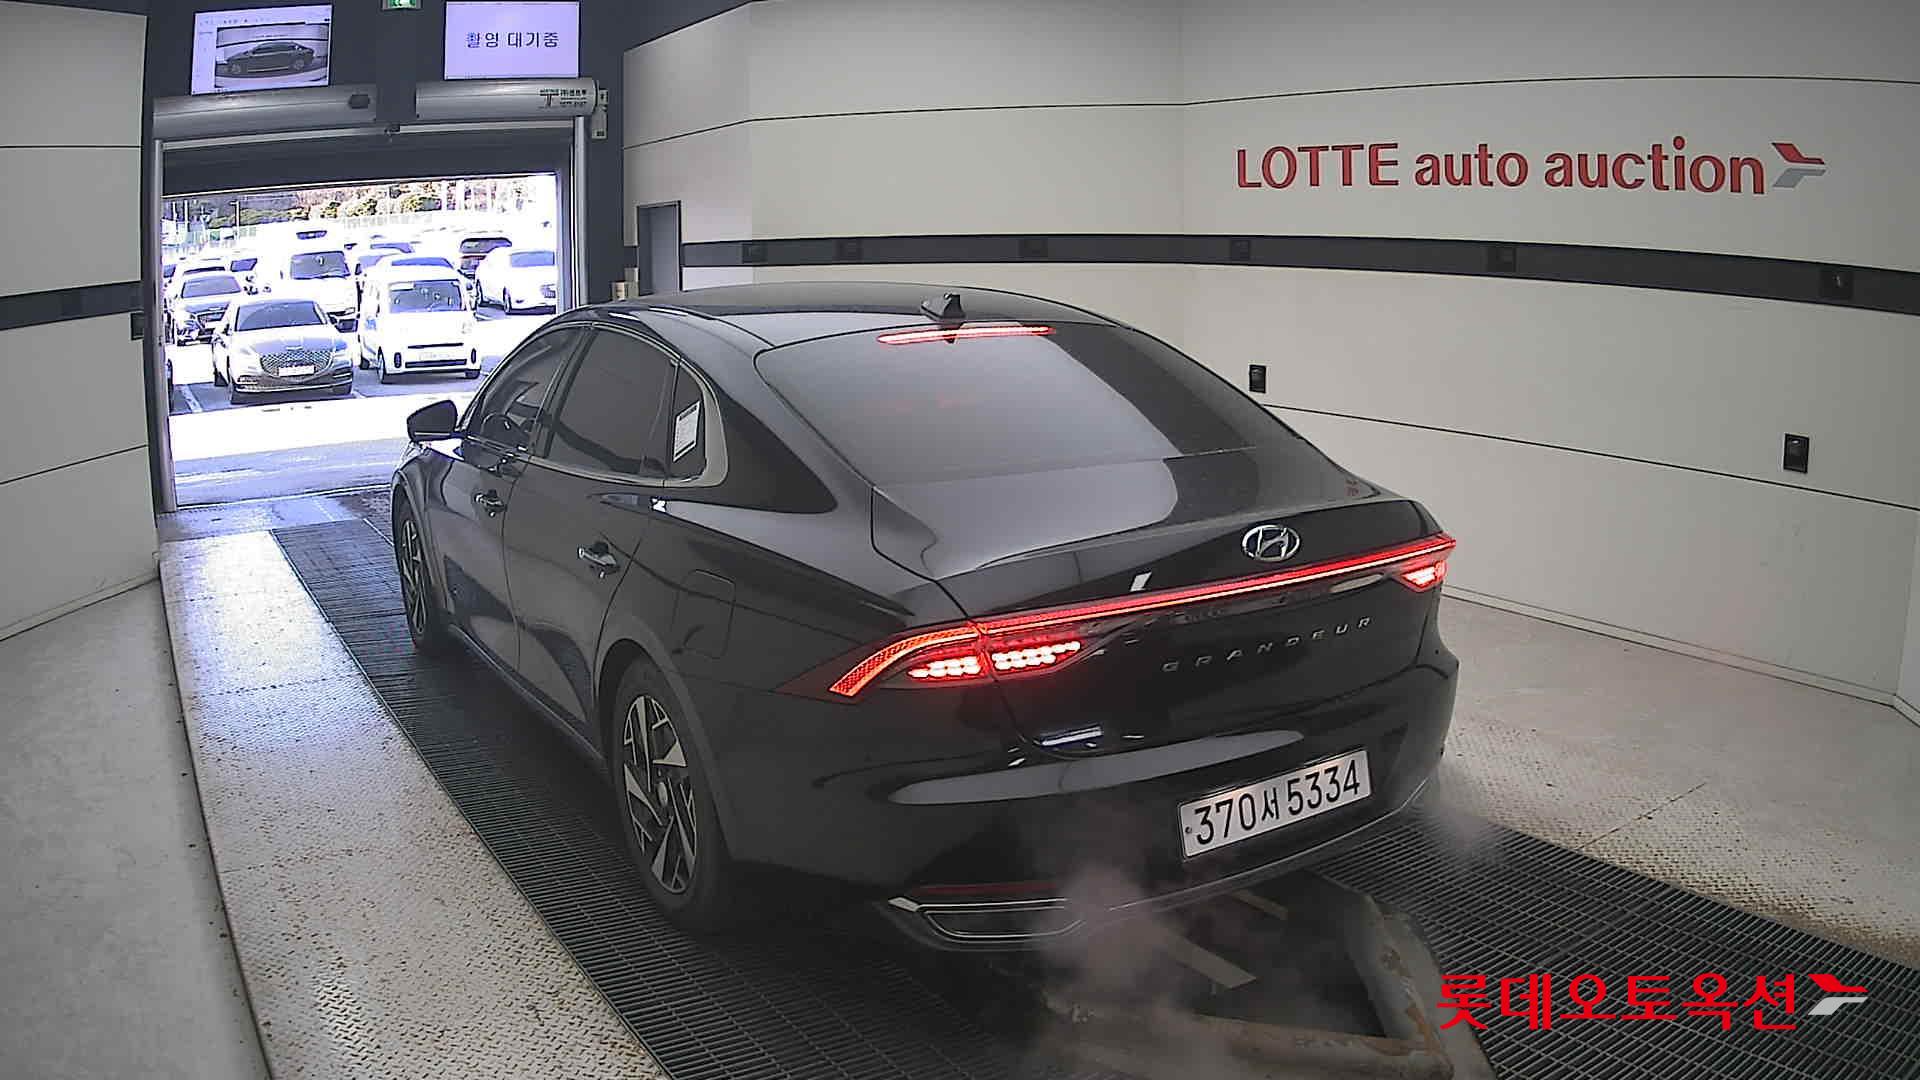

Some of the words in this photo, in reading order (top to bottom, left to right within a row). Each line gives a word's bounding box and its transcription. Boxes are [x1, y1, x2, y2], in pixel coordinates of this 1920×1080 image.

[507, 32, 559, 48] 대기중
[1236, 142, 1399, 189] LOTTE
[1414, 143, 1529, 187] auto
[1544, 136, 1766, 194] auction
[1161, 616, 1373, 672] GRANDEUR
